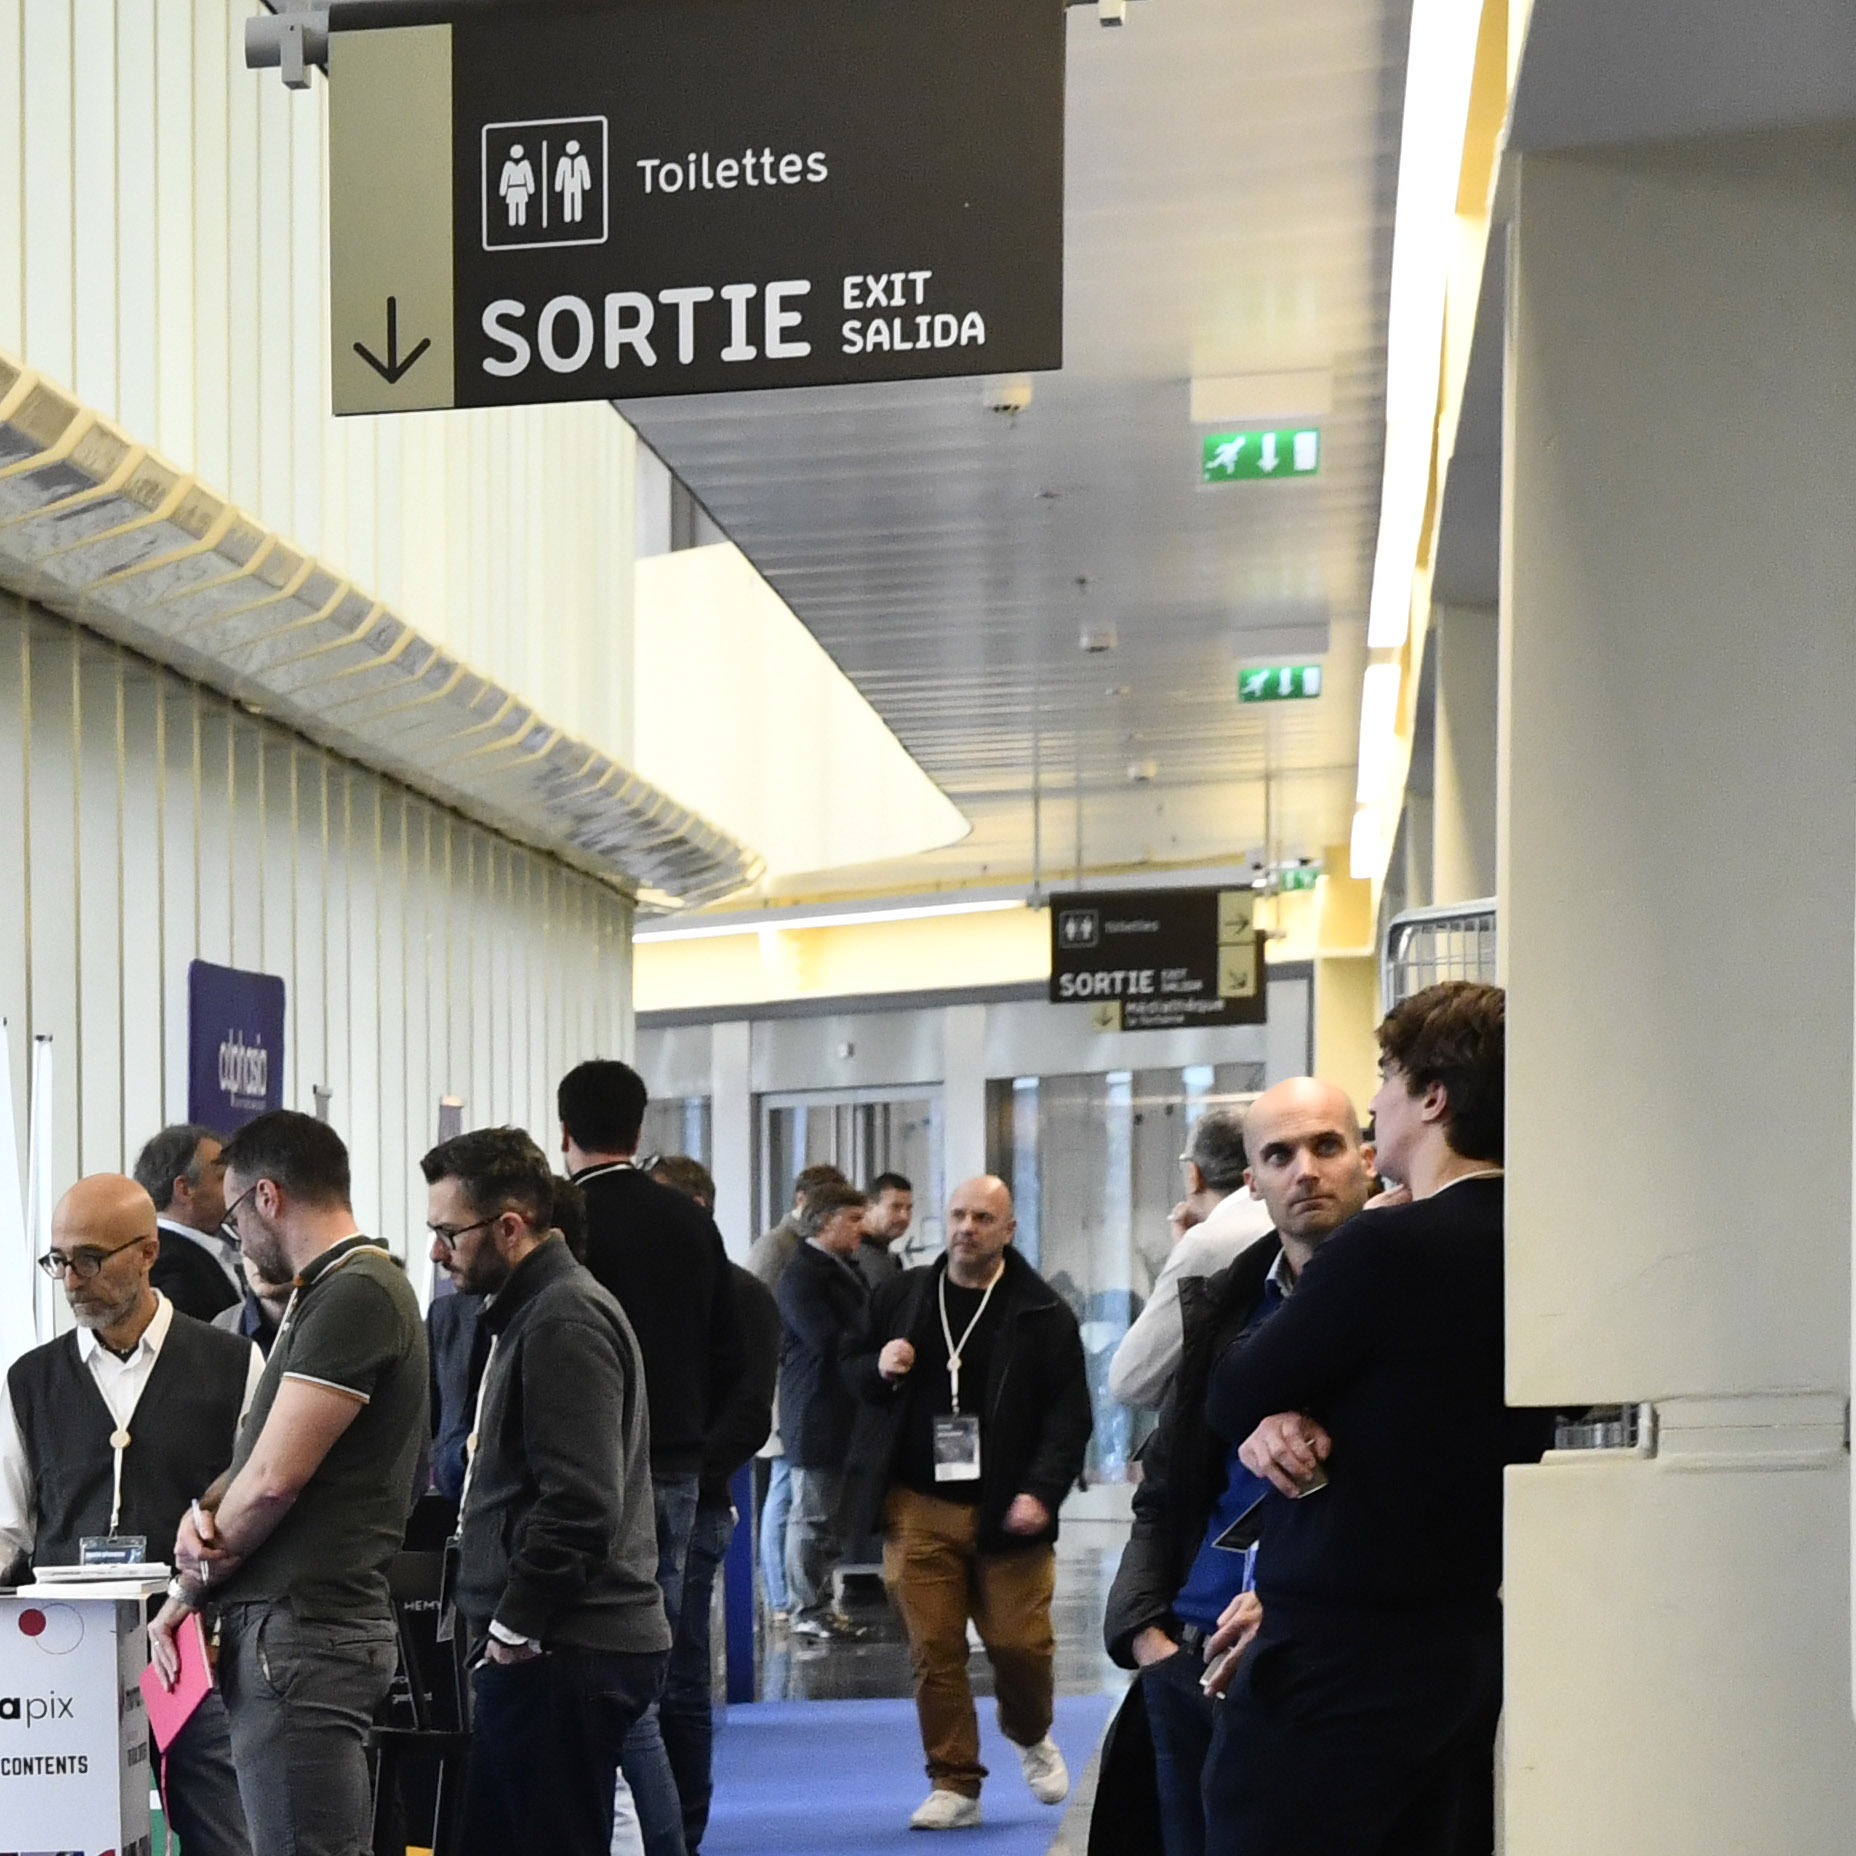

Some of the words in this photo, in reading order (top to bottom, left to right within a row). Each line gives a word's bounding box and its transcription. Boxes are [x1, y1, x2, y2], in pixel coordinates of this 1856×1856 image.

[636, 147, 829, 194] Toilettes
[842, 271, 933, 310] EXIT
[481, 279, 812, 377] SORTIE
[841, 312, 986, 354] SALIDA
[1059, 968, 1155, 997] SORTIE
[1, 1755, 89, 1776] CONTENTS
